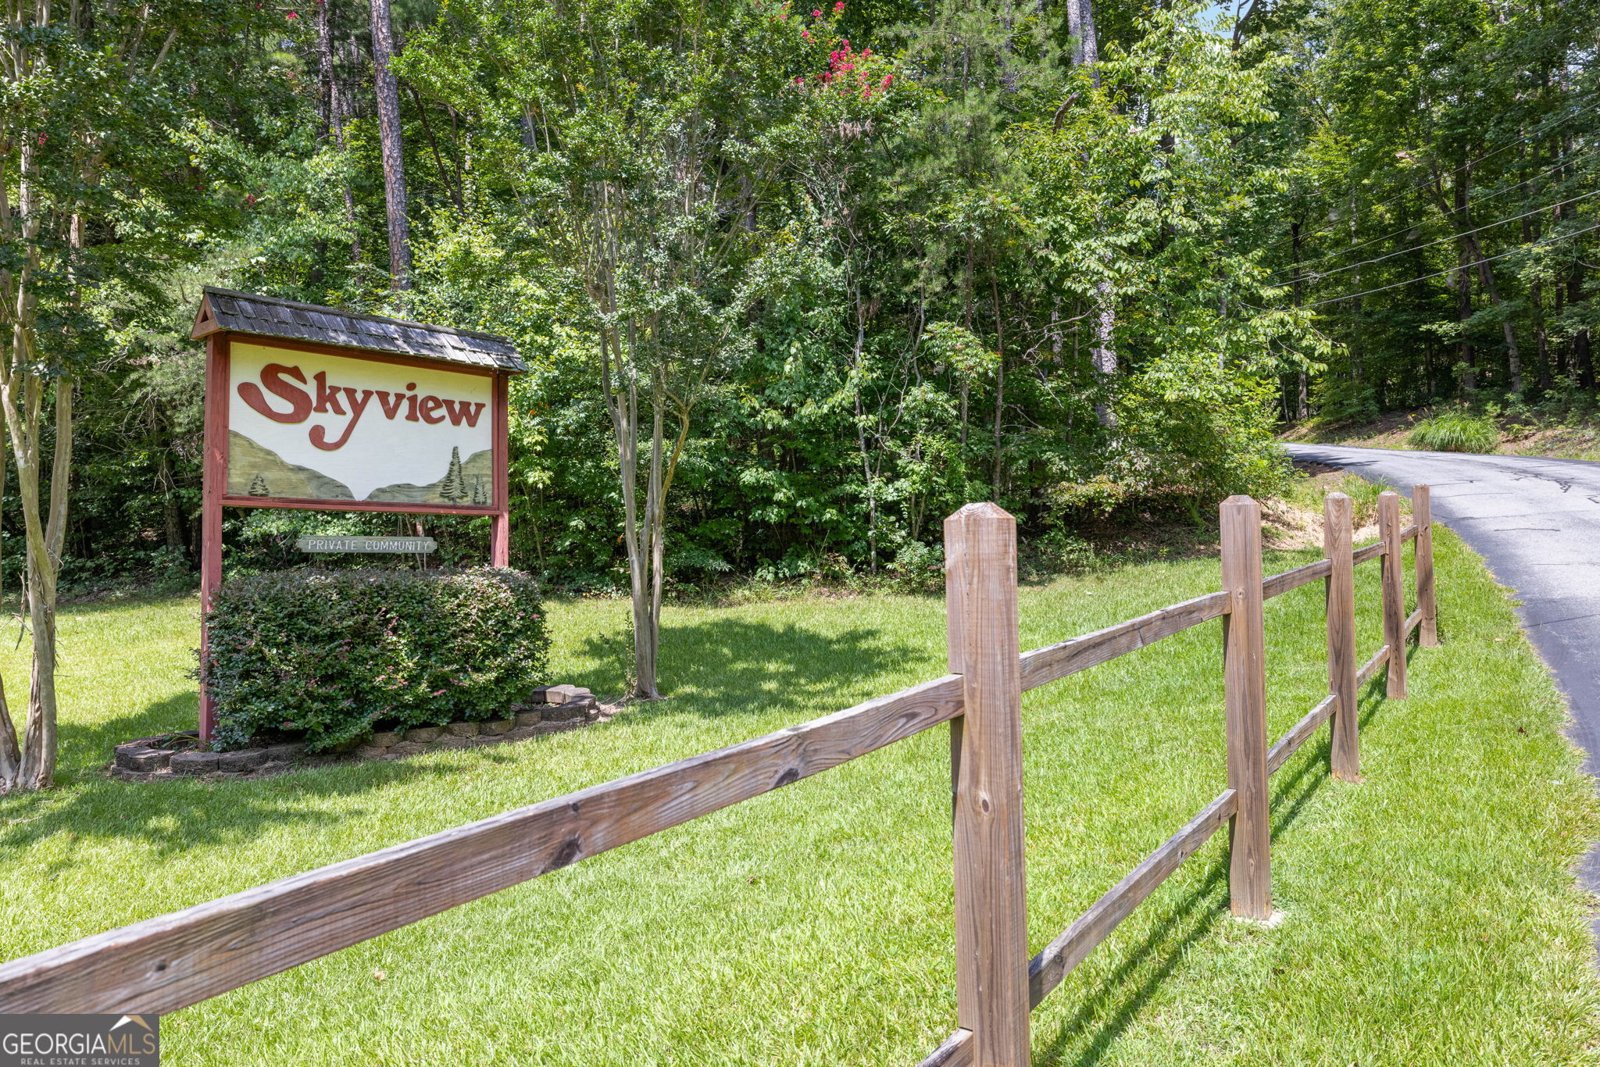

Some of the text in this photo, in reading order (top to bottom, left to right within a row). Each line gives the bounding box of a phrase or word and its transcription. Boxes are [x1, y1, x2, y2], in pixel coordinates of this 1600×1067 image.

[237, 363, 486, 451] Skyview
[308, 540, 431, 551] PRIVATE COMMUNITY
